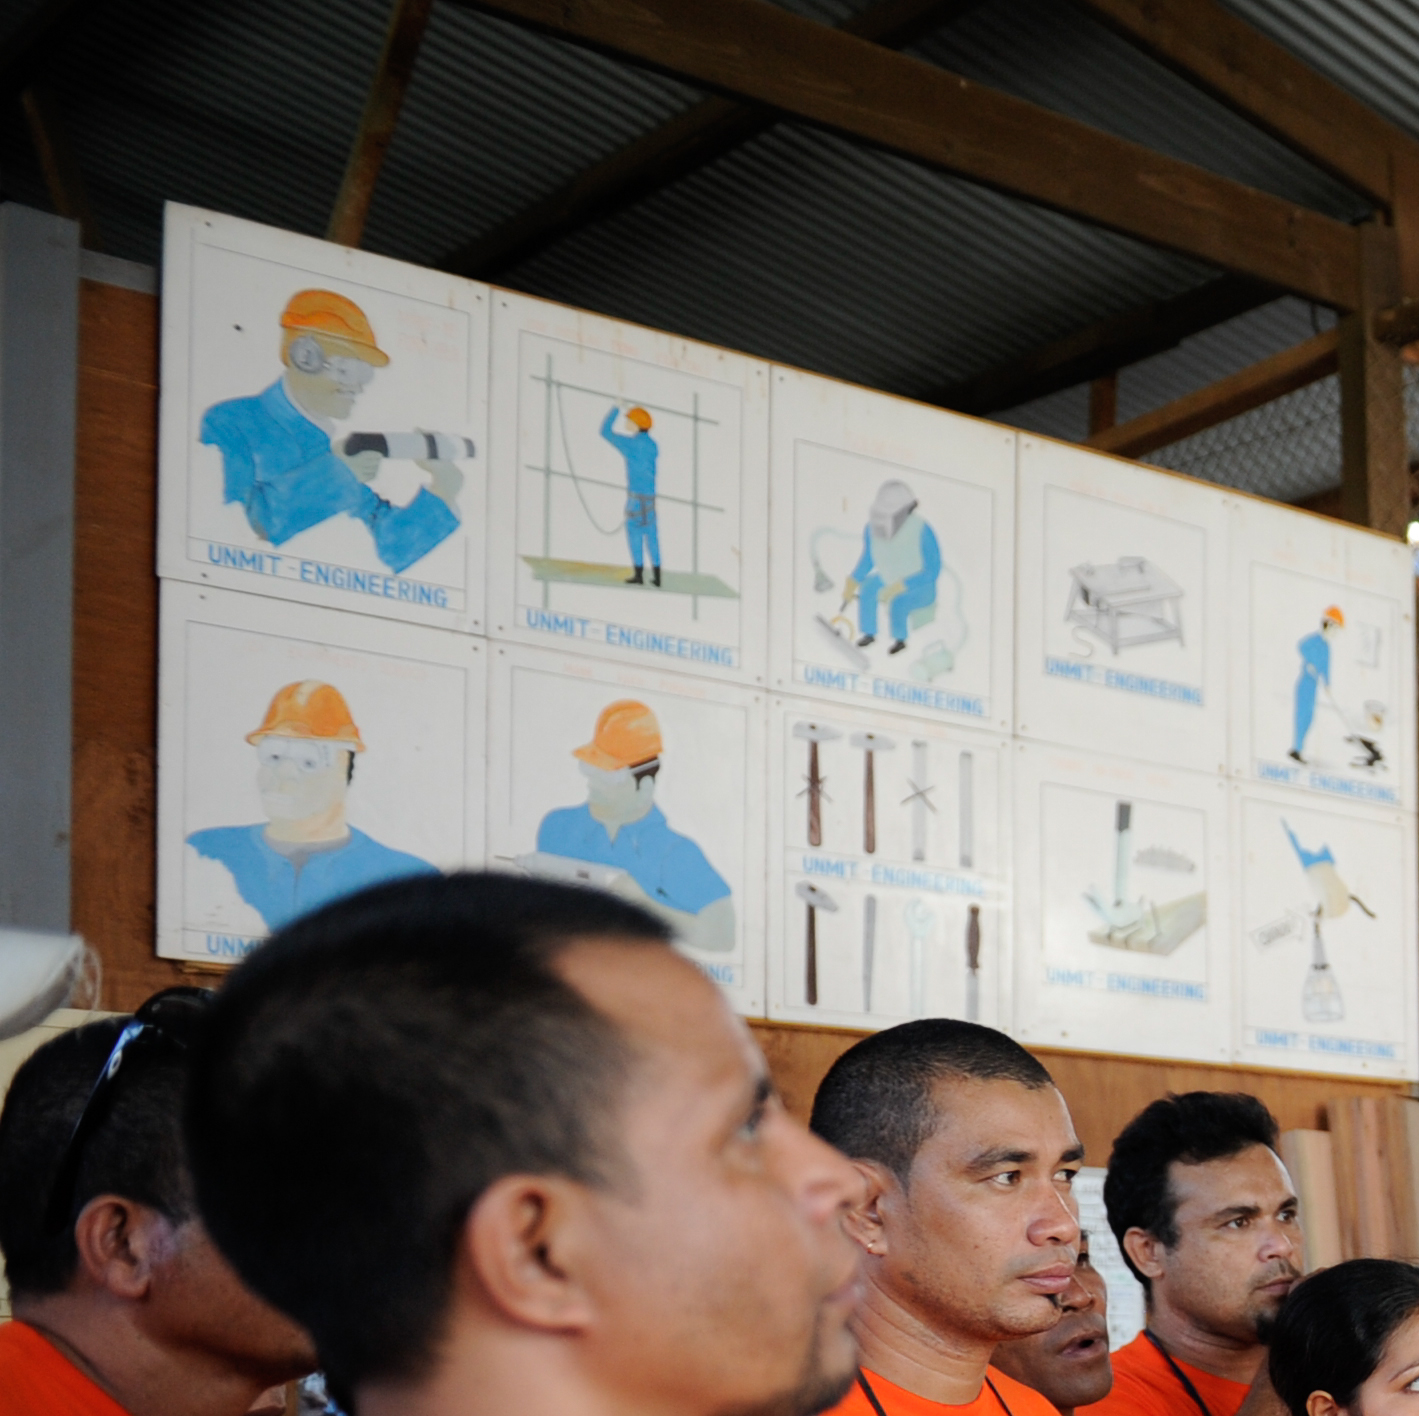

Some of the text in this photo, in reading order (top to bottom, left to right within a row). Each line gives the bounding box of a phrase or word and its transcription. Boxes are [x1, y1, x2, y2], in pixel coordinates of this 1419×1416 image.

[207, 544, 282, 575] UNMIT
[301, 561, 447, 608] ENGINEERING
[526, 608, 589, 637] UNMIT
[606, 624, 733, 667] ENGINEERING
[804, 665, 983, 717] UNMIT ENGINEERING
[1046, 657, 1203, 707] UNMIT ENGINEERING
[1257, 762, 1395, 803] UNMIT ENGINEERING
[802, 855, 984, 897] UNMIT ENGINEERING
[206, 934, 257, 957] UNM
[1046, 967, 1093, 987] UNMIT
[1255, 1029, 1298, 1047] UNMIT
